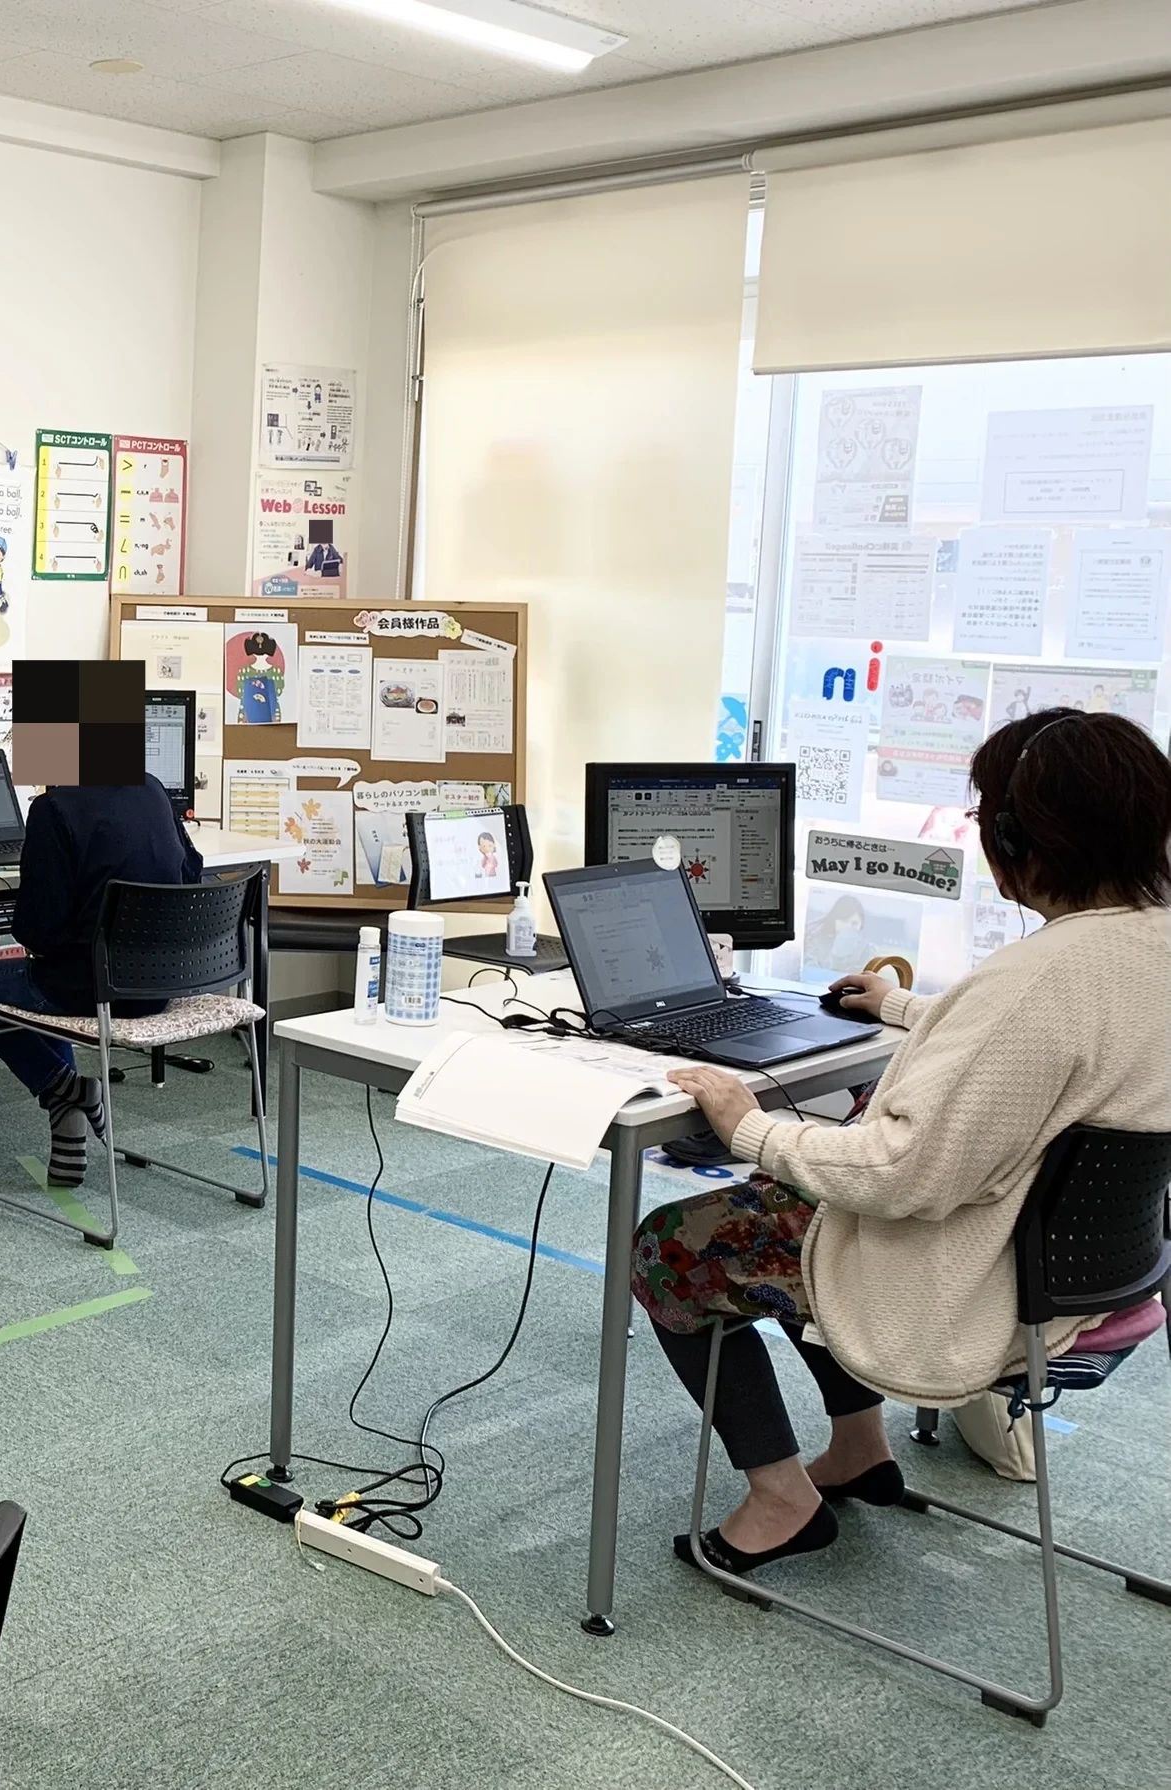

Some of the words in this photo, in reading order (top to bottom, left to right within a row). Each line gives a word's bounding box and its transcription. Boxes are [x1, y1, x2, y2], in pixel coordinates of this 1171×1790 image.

[55, 435, 107, 446] SCTコントロール
[132, 440, 181, 452] PCTコントロール
[261, 499, 291, 512] Web
[304, 500, 345, 514] Lesson
[378, 618, 439, 630] 会員様作品
[812, 858, 849, 873] May
[854, 858, 861, 870] I
[866, 862, 888, 875] go
[893, 862, 956, 892] home?
